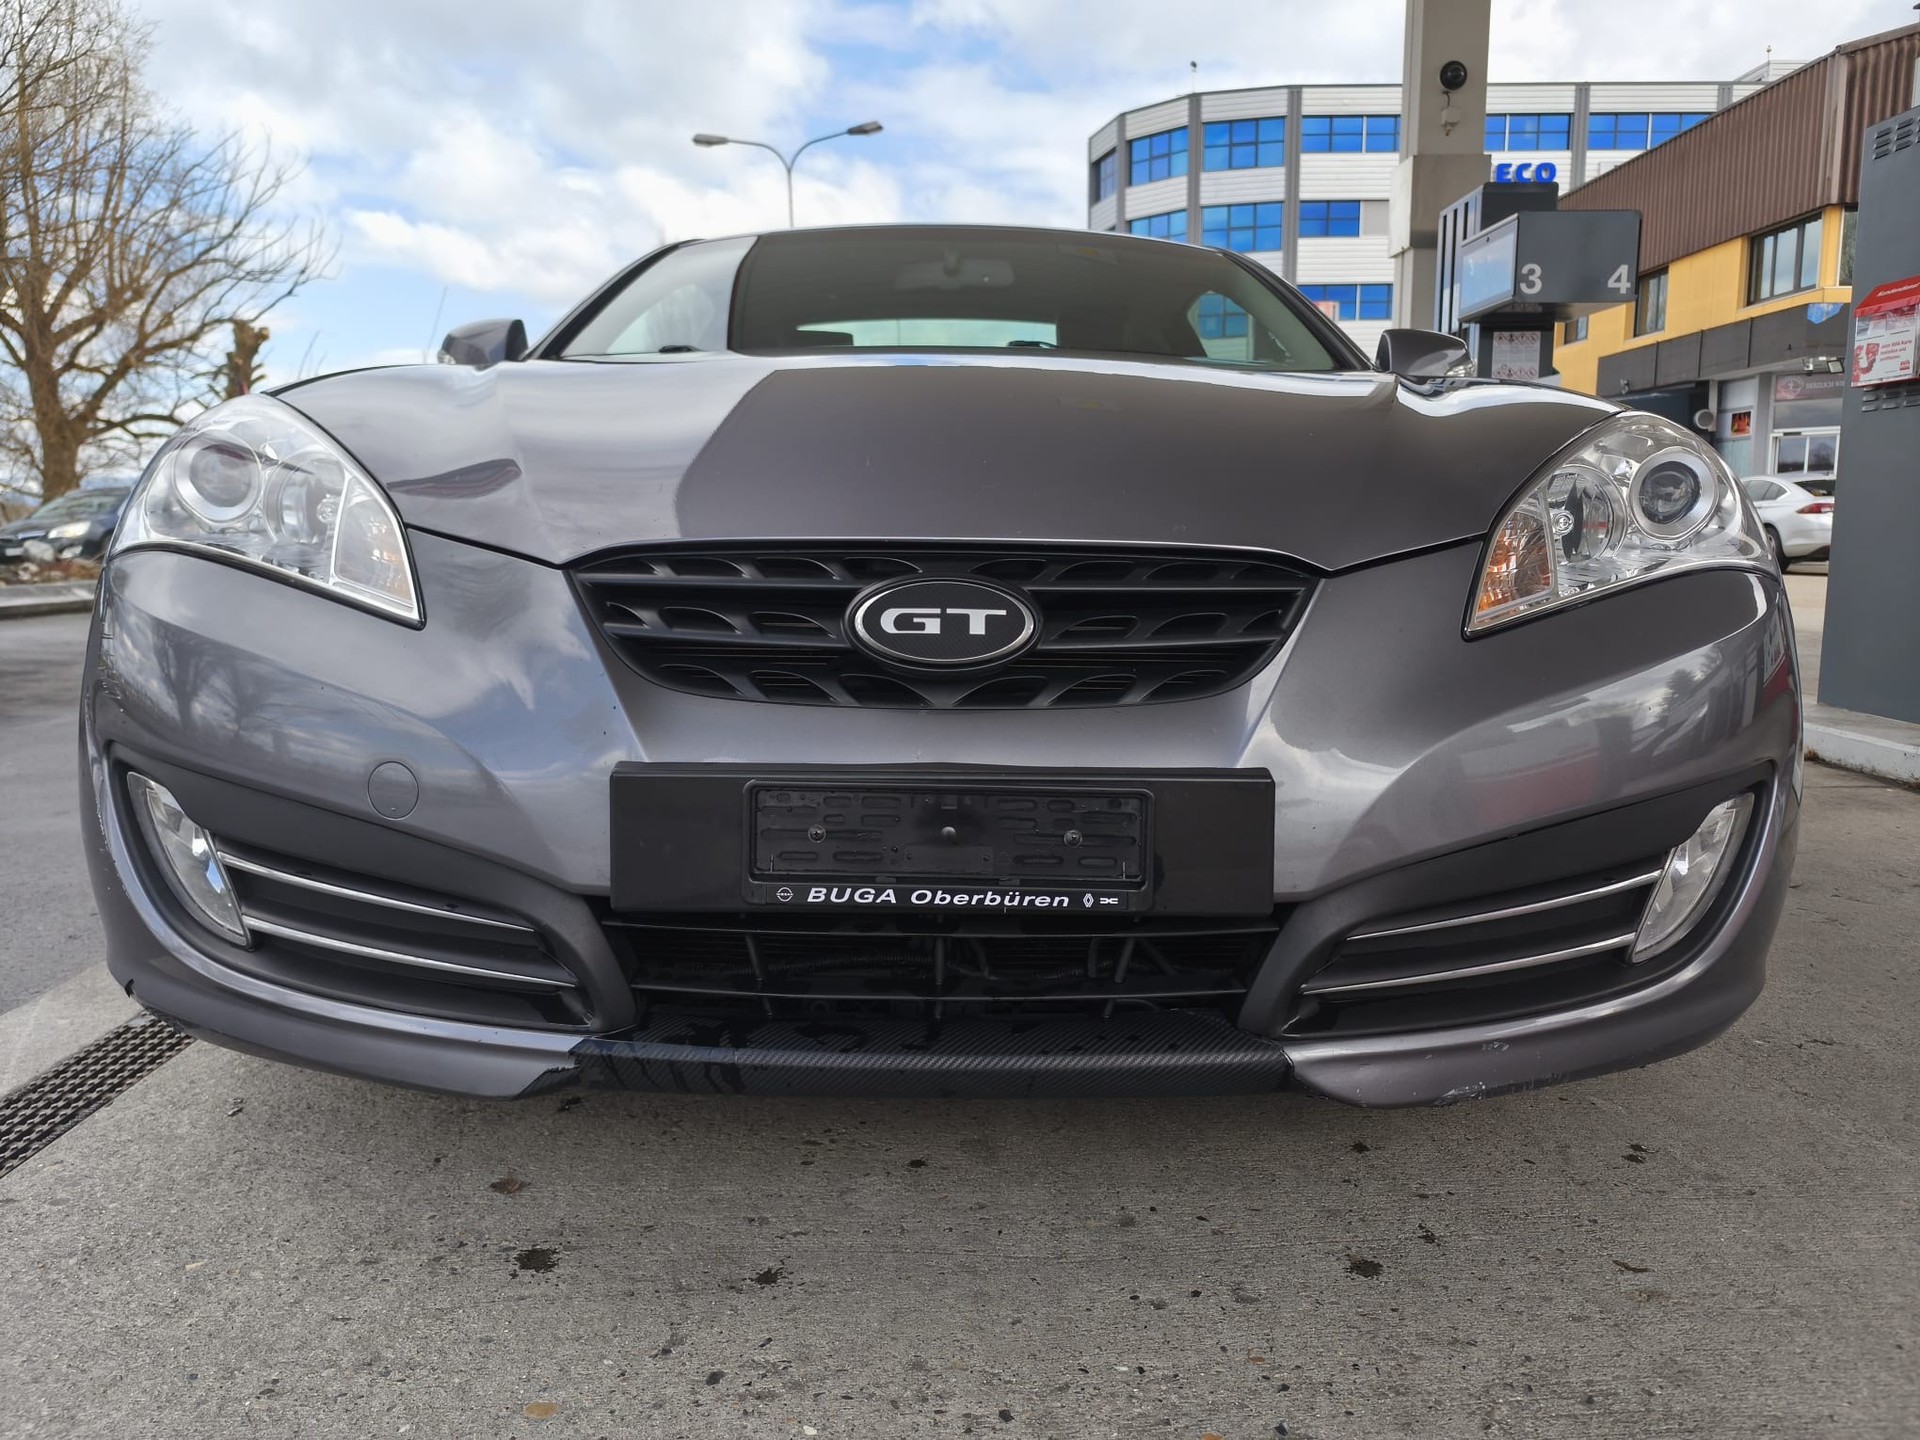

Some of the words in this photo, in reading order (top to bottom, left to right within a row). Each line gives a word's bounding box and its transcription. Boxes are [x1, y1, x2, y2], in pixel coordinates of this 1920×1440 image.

[1519, 263, 1542, 294] 3
[1607, 264, 1631, 294] 4
[880, 608, 1006, 635] GT
[806, 887, 897, 903] BUGA
[910, 889, 1069, 907] Oberbüren
